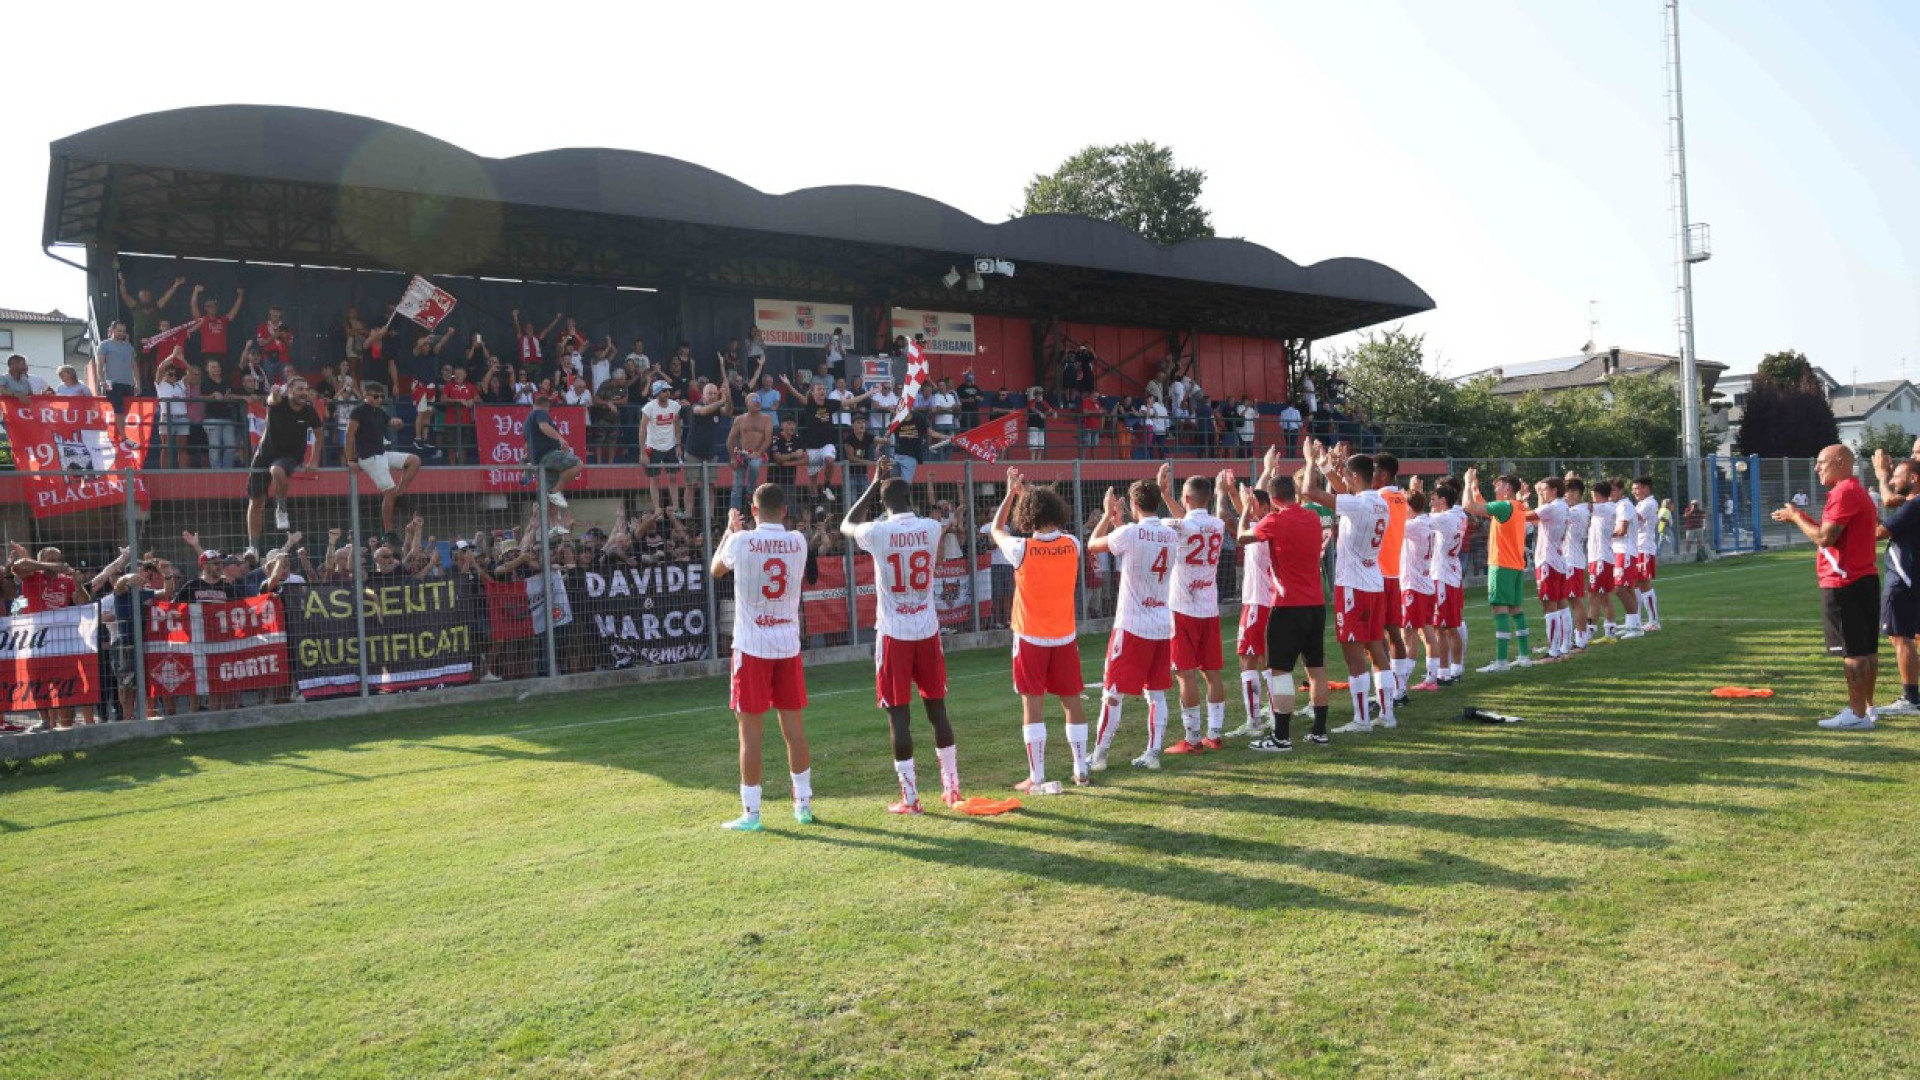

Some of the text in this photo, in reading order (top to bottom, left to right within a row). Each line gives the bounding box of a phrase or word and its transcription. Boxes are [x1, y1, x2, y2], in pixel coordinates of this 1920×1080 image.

[749, 537, 802, 554] SANTELLA
[890, 531, 929, 547] NDOYE
[1185, 533, 1222, 565] 28
[1371, 519, 1386, 548] 9
[585, 563, 702, 597] DAVIDE
[762, 557, 787, 599] 3
[886, 550, 930, 593] 18
[1151, 546, 1168, 582] 4
[304, 580, 455, 619] ASSENTI
[151, 600, 276, 634] PC 1919
[595, 609, 704, 640] MARCO
[300, 624, 469, 667] GIUSTIFICATI
[219, 654, 280, 682] CORTE
